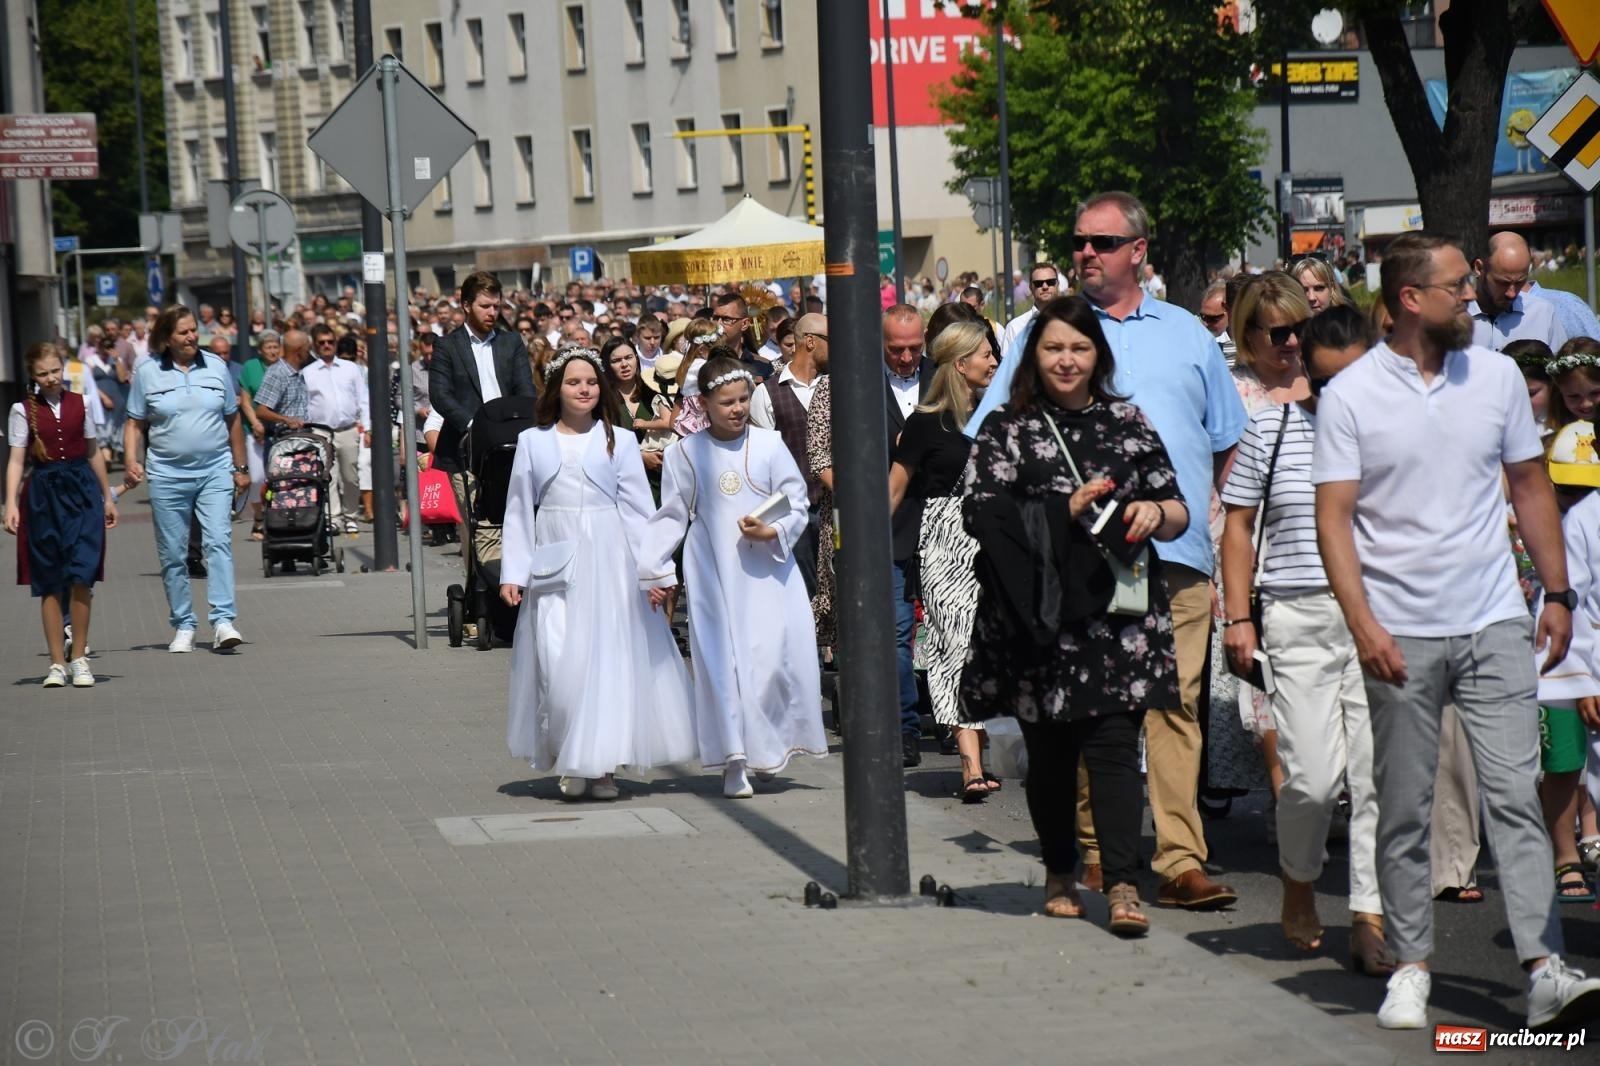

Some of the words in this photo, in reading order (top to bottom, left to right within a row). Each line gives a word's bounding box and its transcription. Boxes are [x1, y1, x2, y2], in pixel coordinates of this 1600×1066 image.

[1503, 203, 1532, 214] Salon
[575, 251, 589, 271] P
[740, 256, 764, 270] MNIE
